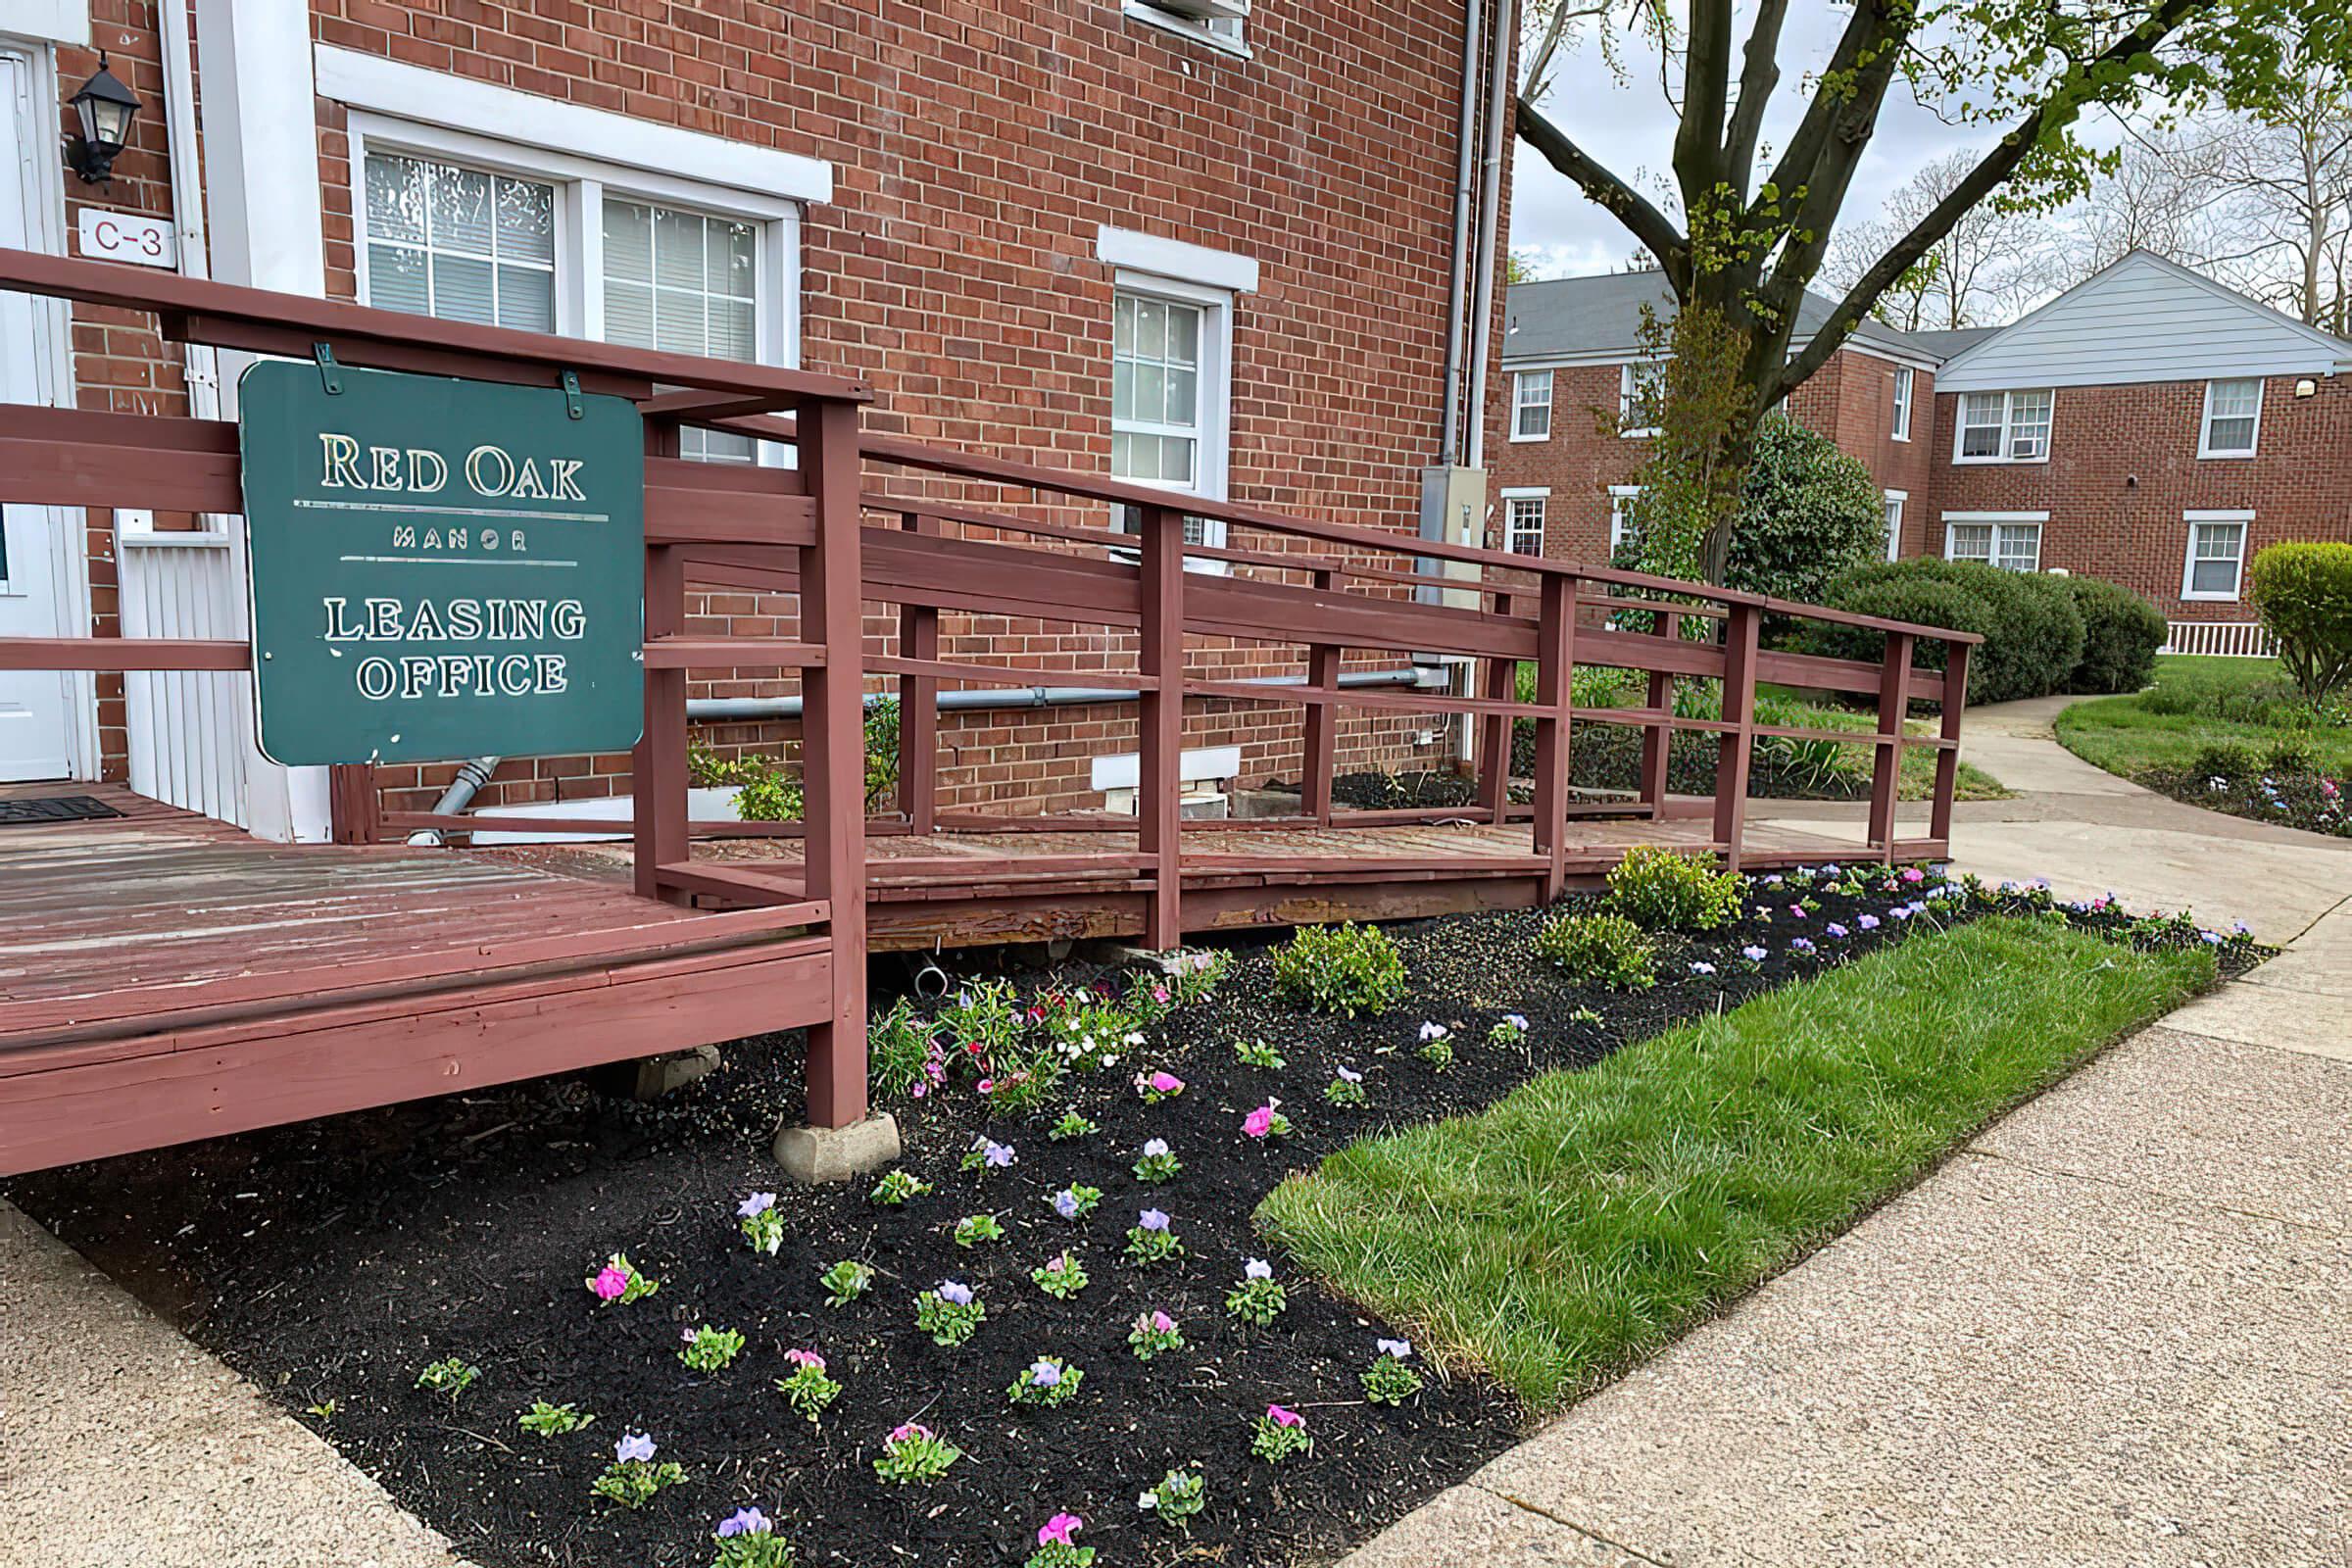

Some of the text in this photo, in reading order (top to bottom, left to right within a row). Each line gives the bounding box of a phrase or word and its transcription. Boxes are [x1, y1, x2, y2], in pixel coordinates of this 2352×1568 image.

[95, 220, 162, 256] C-3
[318, 433, 587, 501] RED OAK
[393, 525, 526, 551] MANOR
[323, 597, 587, 641] LEASING
[356, 654, 568, 701] OFFICE
